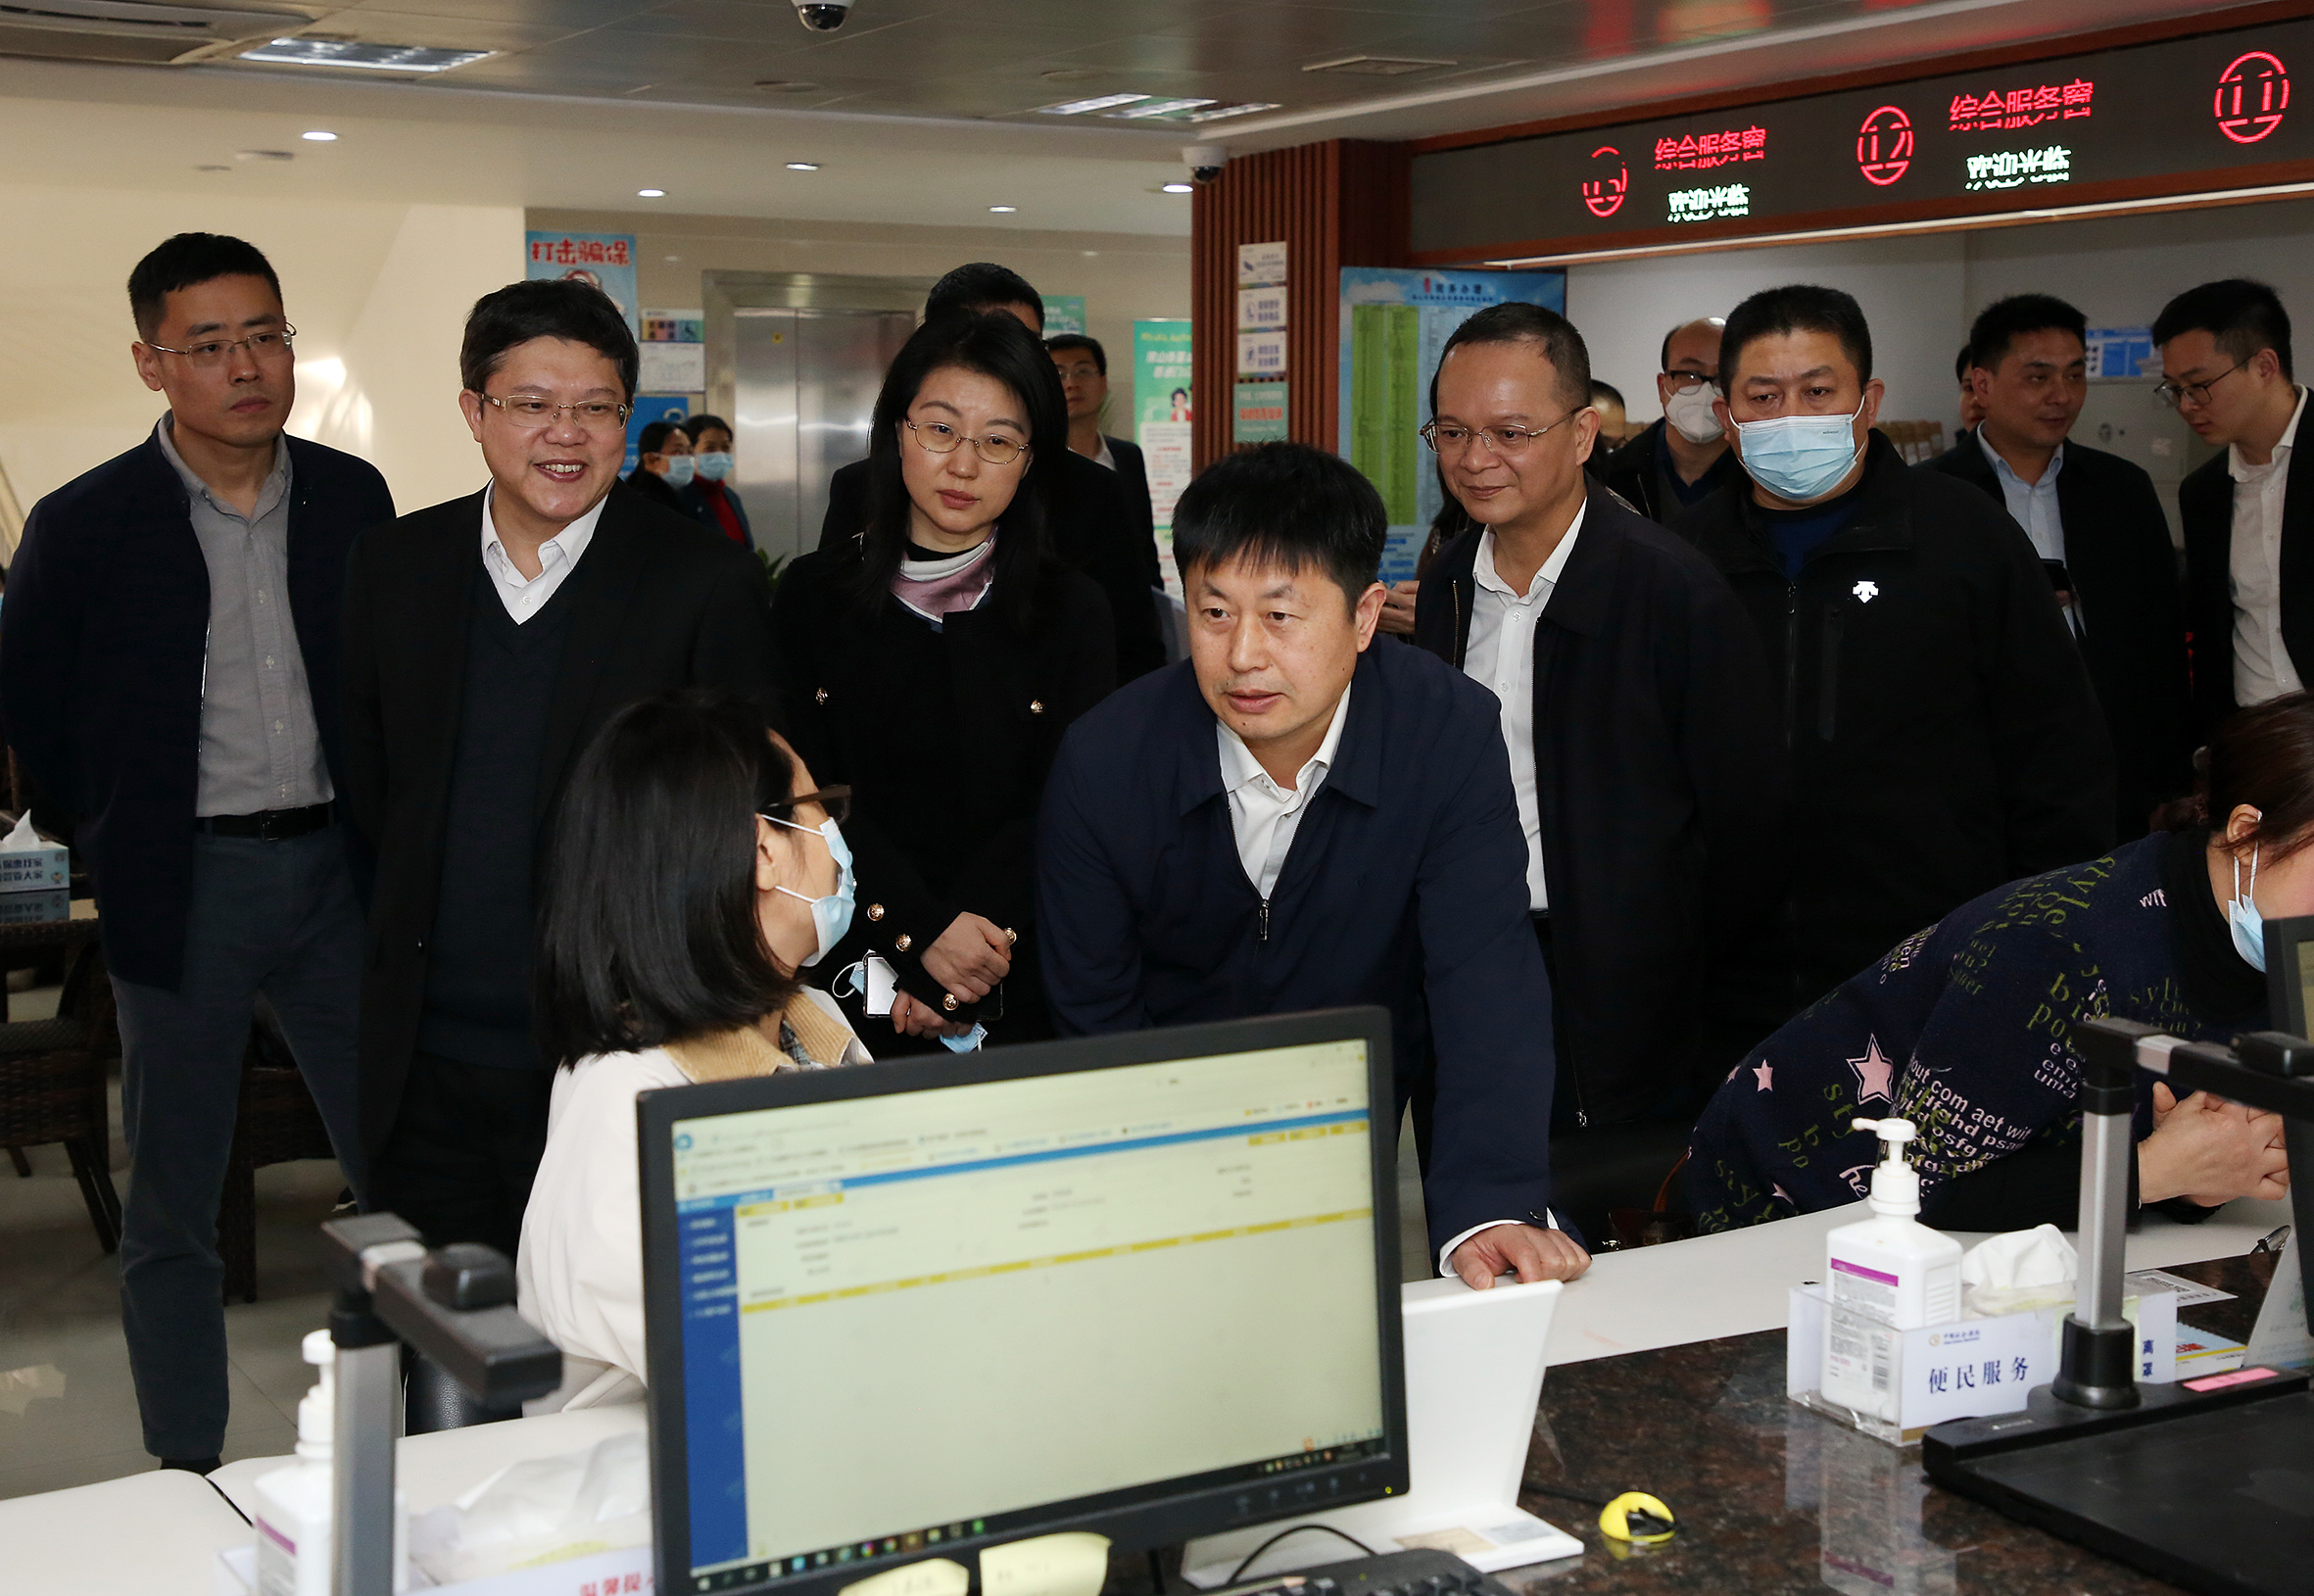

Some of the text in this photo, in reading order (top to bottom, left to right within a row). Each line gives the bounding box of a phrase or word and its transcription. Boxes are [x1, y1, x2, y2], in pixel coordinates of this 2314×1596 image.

[1948, 77, 2095, 131] 综合服务窗
[1654, 124, 1767, 170] 综合服务窗
[1964, 144, 2072, 191] 欢迎光临
[1666, 182, 1751, 223] 欢迎光临
[530, 238, 630, 266] 打击骗保
[1930, 1080, 1969, 1113] com
[1971, 1107, 2005, 1133] aet
[1929, 1356, 2029, 1394] 便民服务
